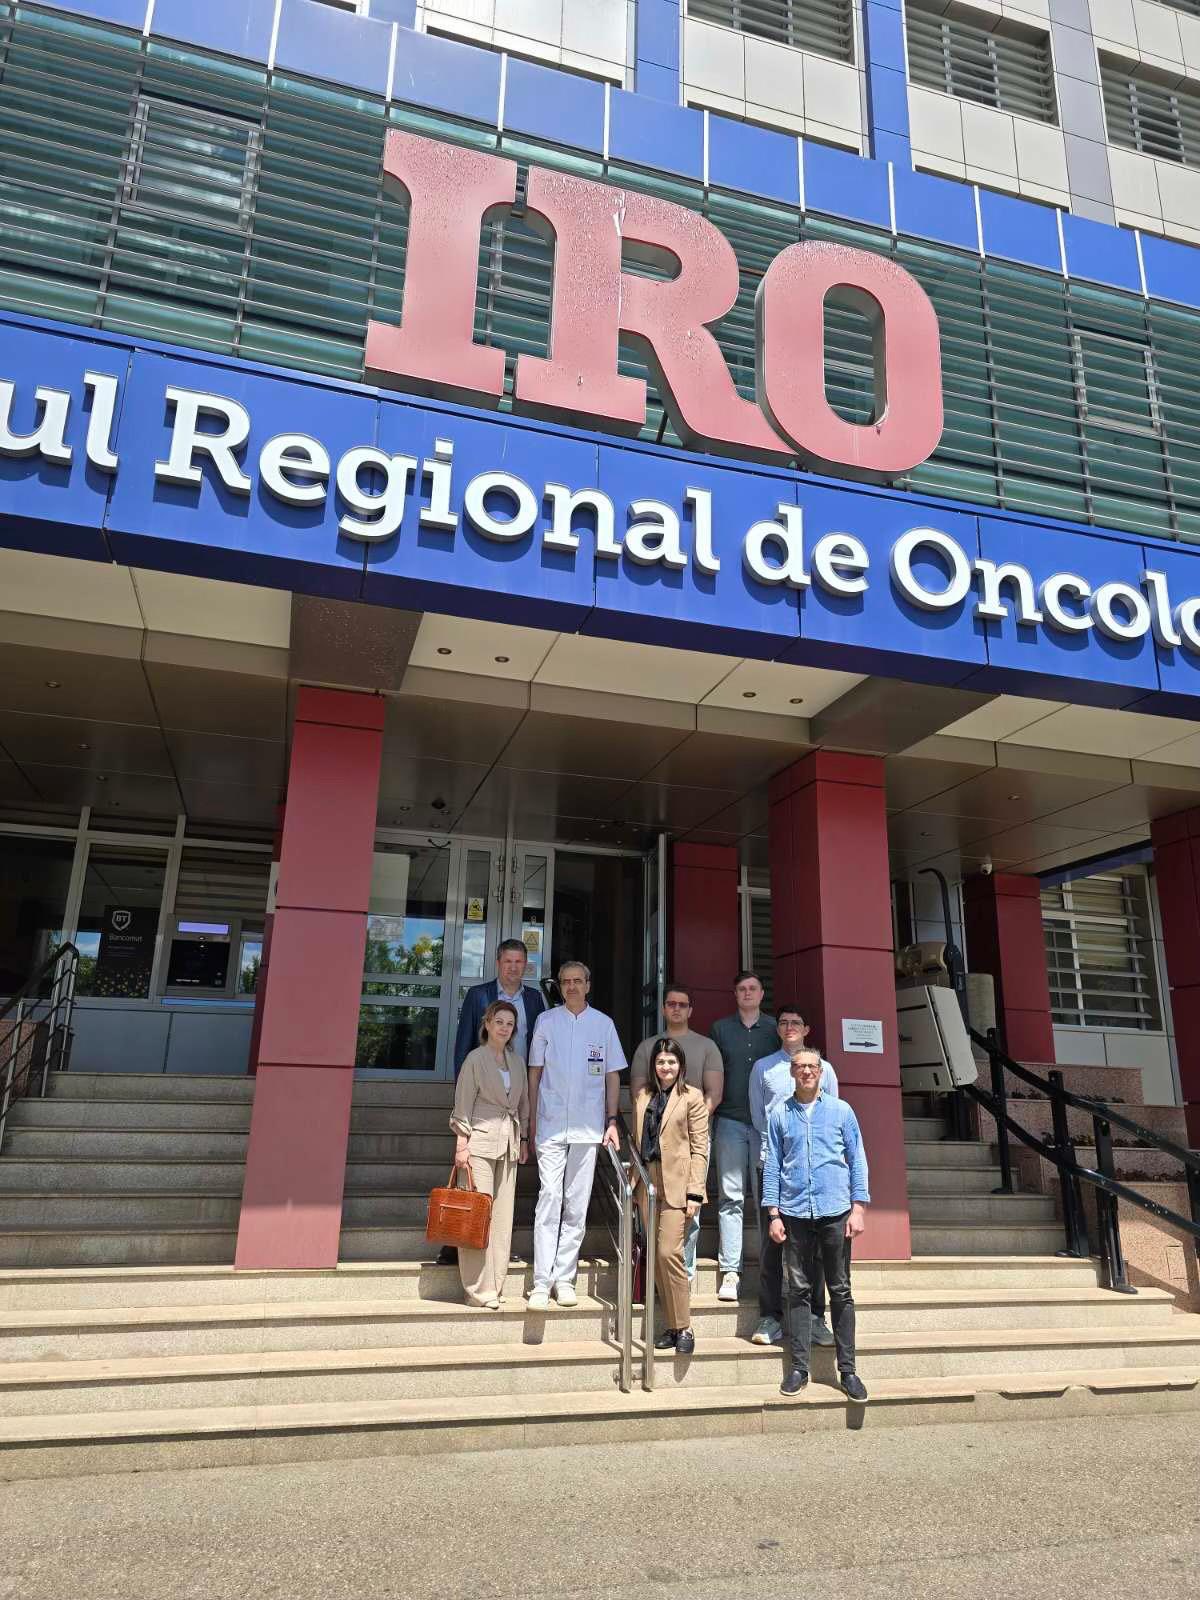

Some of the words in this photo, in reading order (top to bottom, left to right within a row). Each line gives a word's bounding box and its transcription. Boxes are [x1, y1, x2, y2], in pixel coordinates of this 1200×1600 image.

[365, 128, 944, 472] IRO
[155, 385, 721, 574] Regional
[742, 502, 870, 597] de
